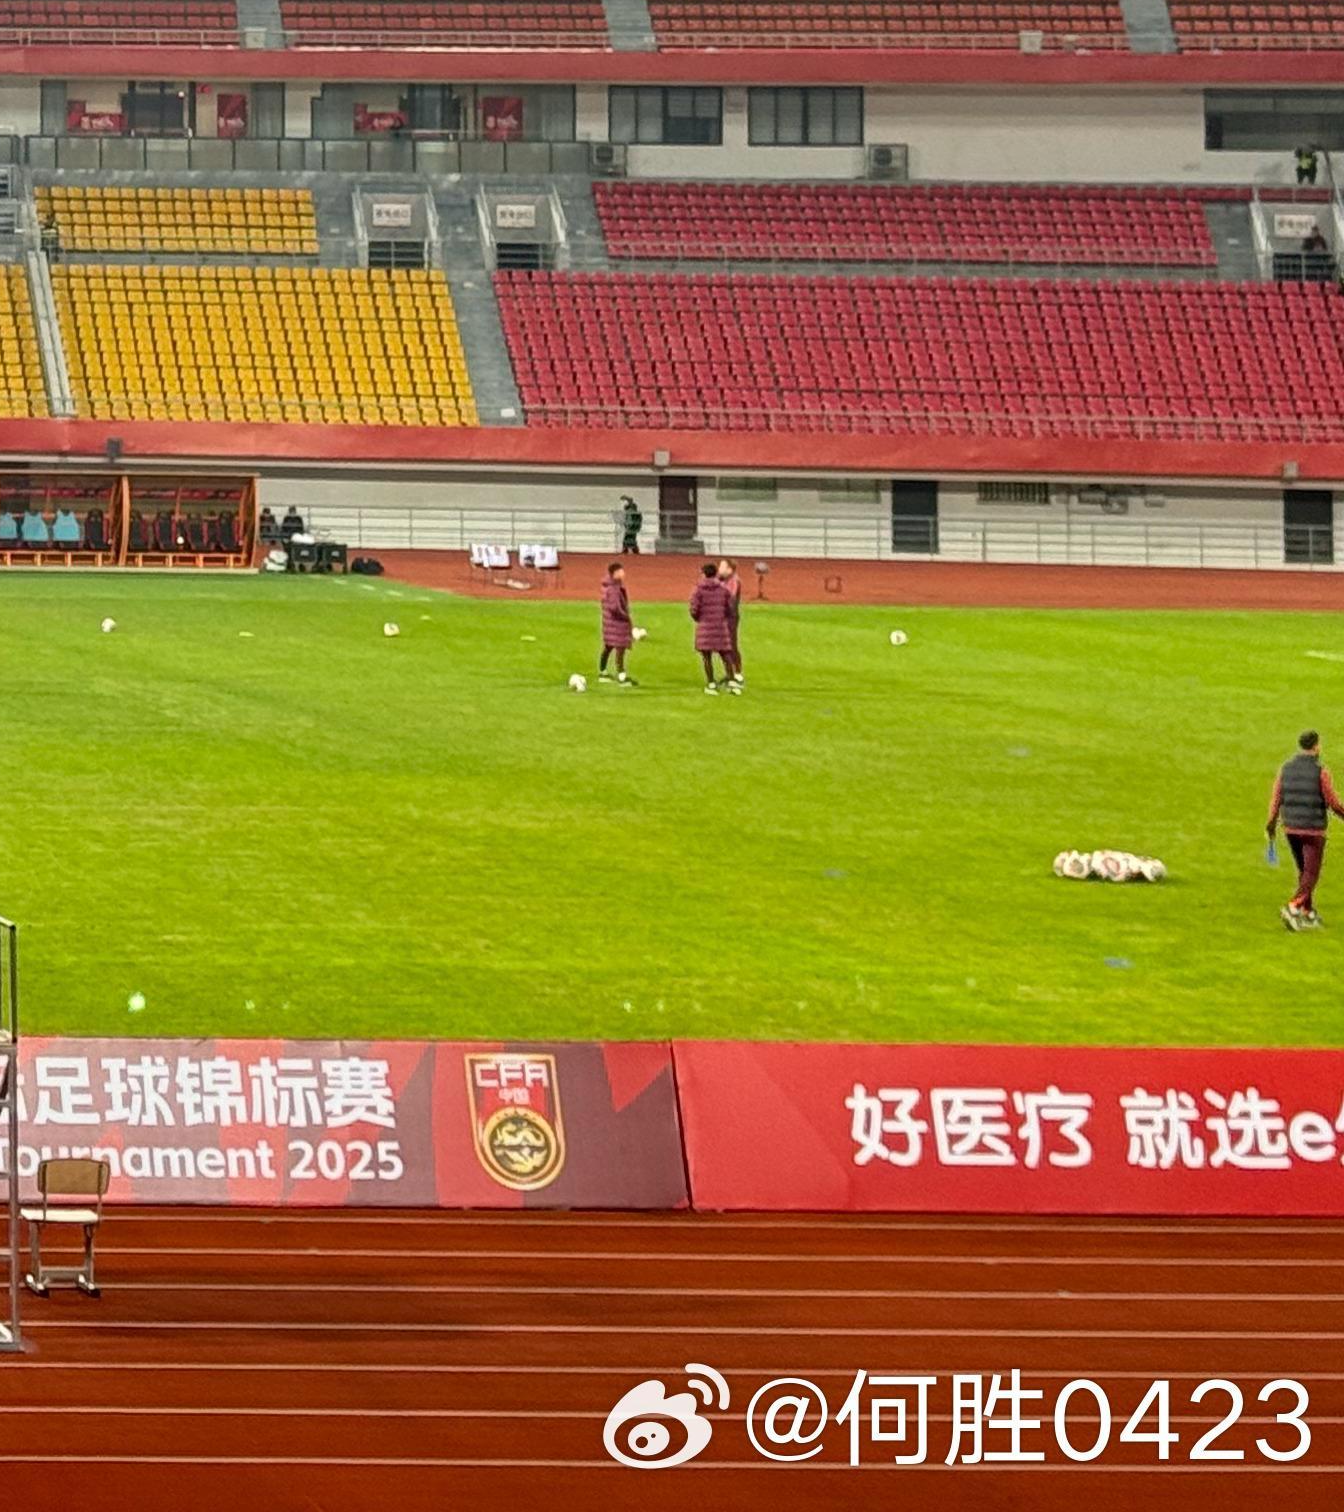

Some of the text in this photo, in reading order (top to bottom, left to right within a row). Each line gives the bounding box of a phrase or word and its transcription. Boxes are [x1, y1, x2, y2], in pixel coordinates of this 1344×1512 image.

[475, 1061, 549, 1088] CFA
[844, 1084, 1344, 1169] 好医疗 就选e
[291, 1142, 403, 1181] 2025
